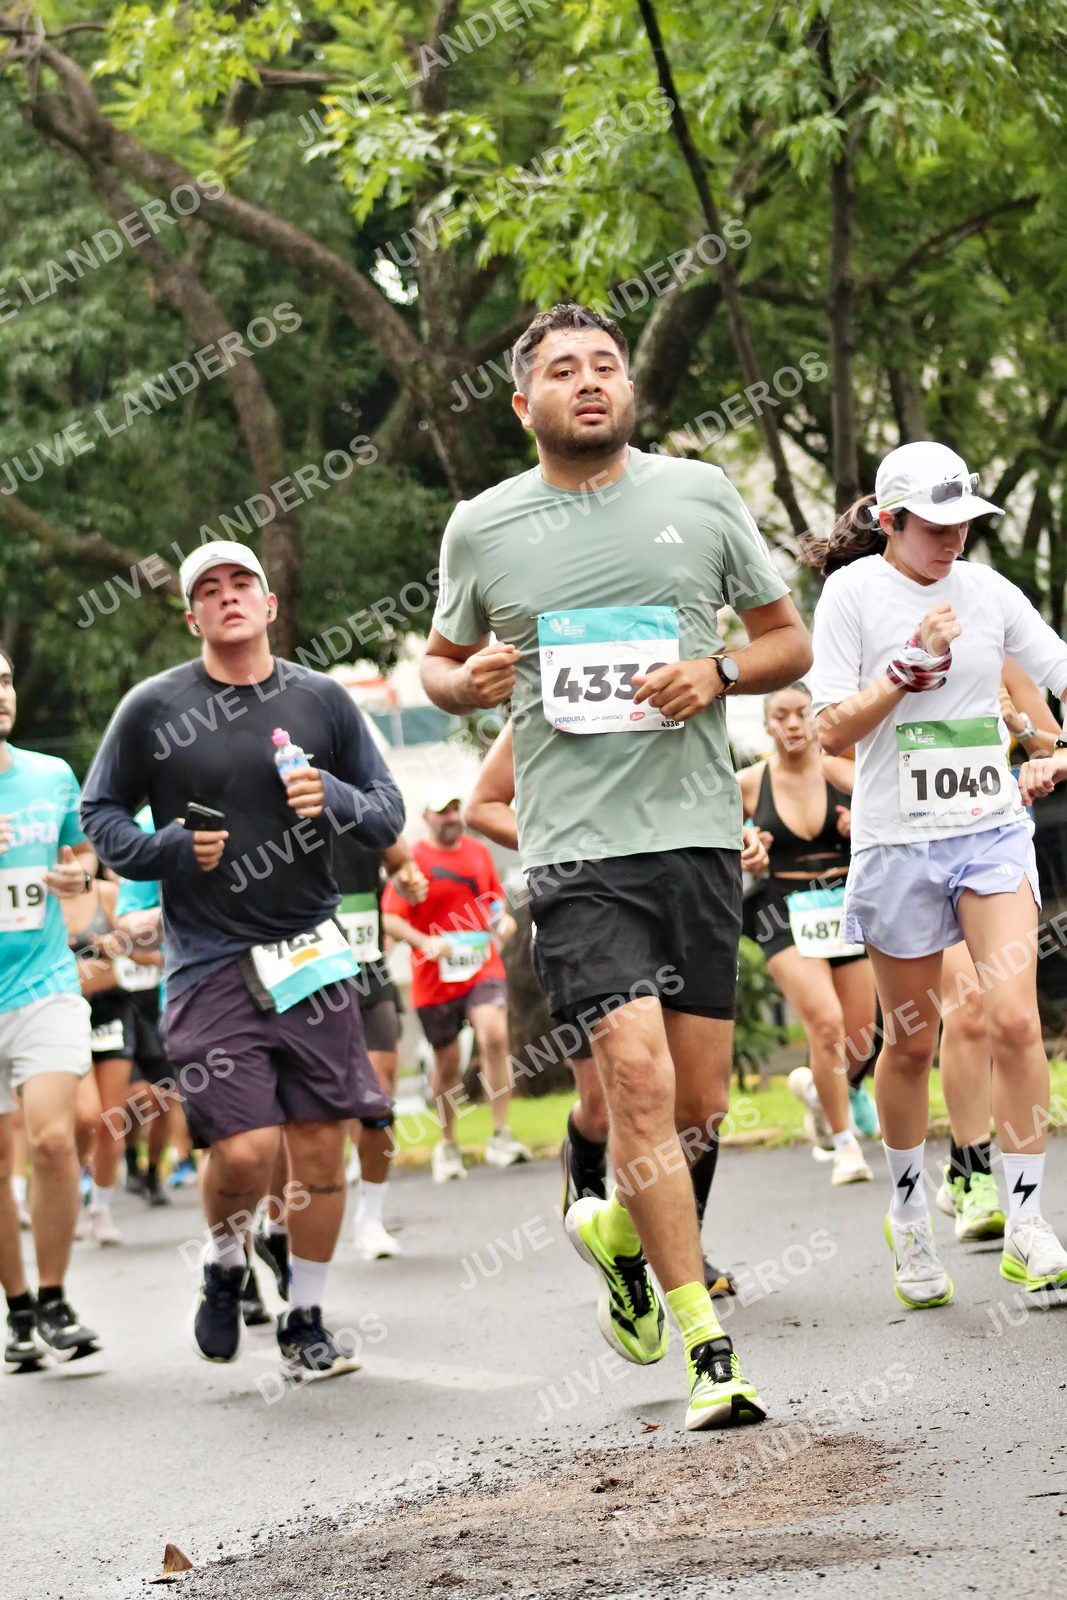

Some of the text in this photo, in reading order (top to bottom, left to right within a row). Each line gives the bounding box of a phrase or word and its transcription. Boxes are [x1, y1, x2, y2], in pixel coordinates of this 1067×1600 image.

[554, 716, 586, 724] PERDURA
[660, 720, 680, 728] 4336
[911, 766, 1001, 800] 1040
